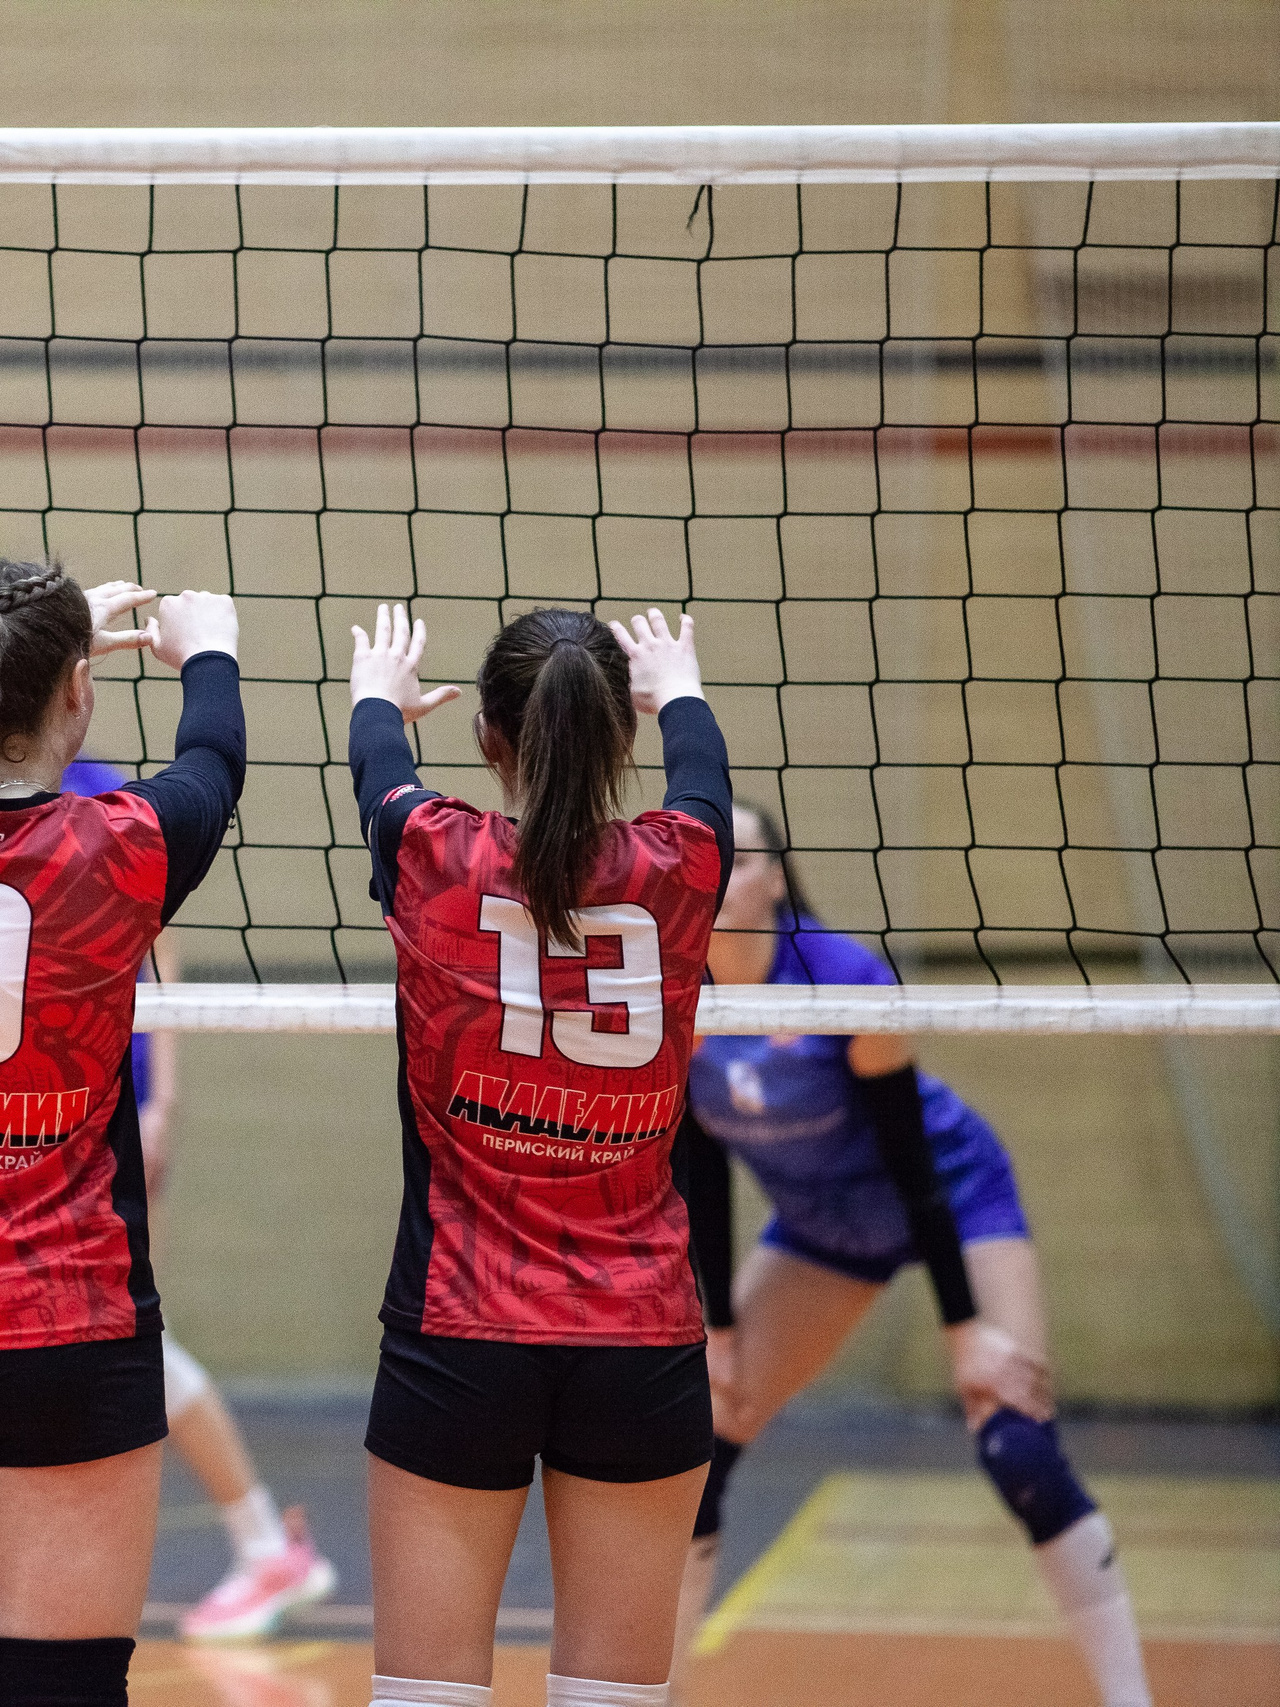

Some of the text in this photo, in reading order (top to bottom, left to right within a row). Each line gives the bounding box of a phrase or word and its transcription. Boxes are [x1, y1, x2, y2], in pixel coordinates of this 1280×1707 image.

[477, 892, 665, 1069] 13
[446, 1070, 679, 1146] АКАДЕМИЯ
[482, 1133, 585, 1162] ПЕРМСКИЙ
